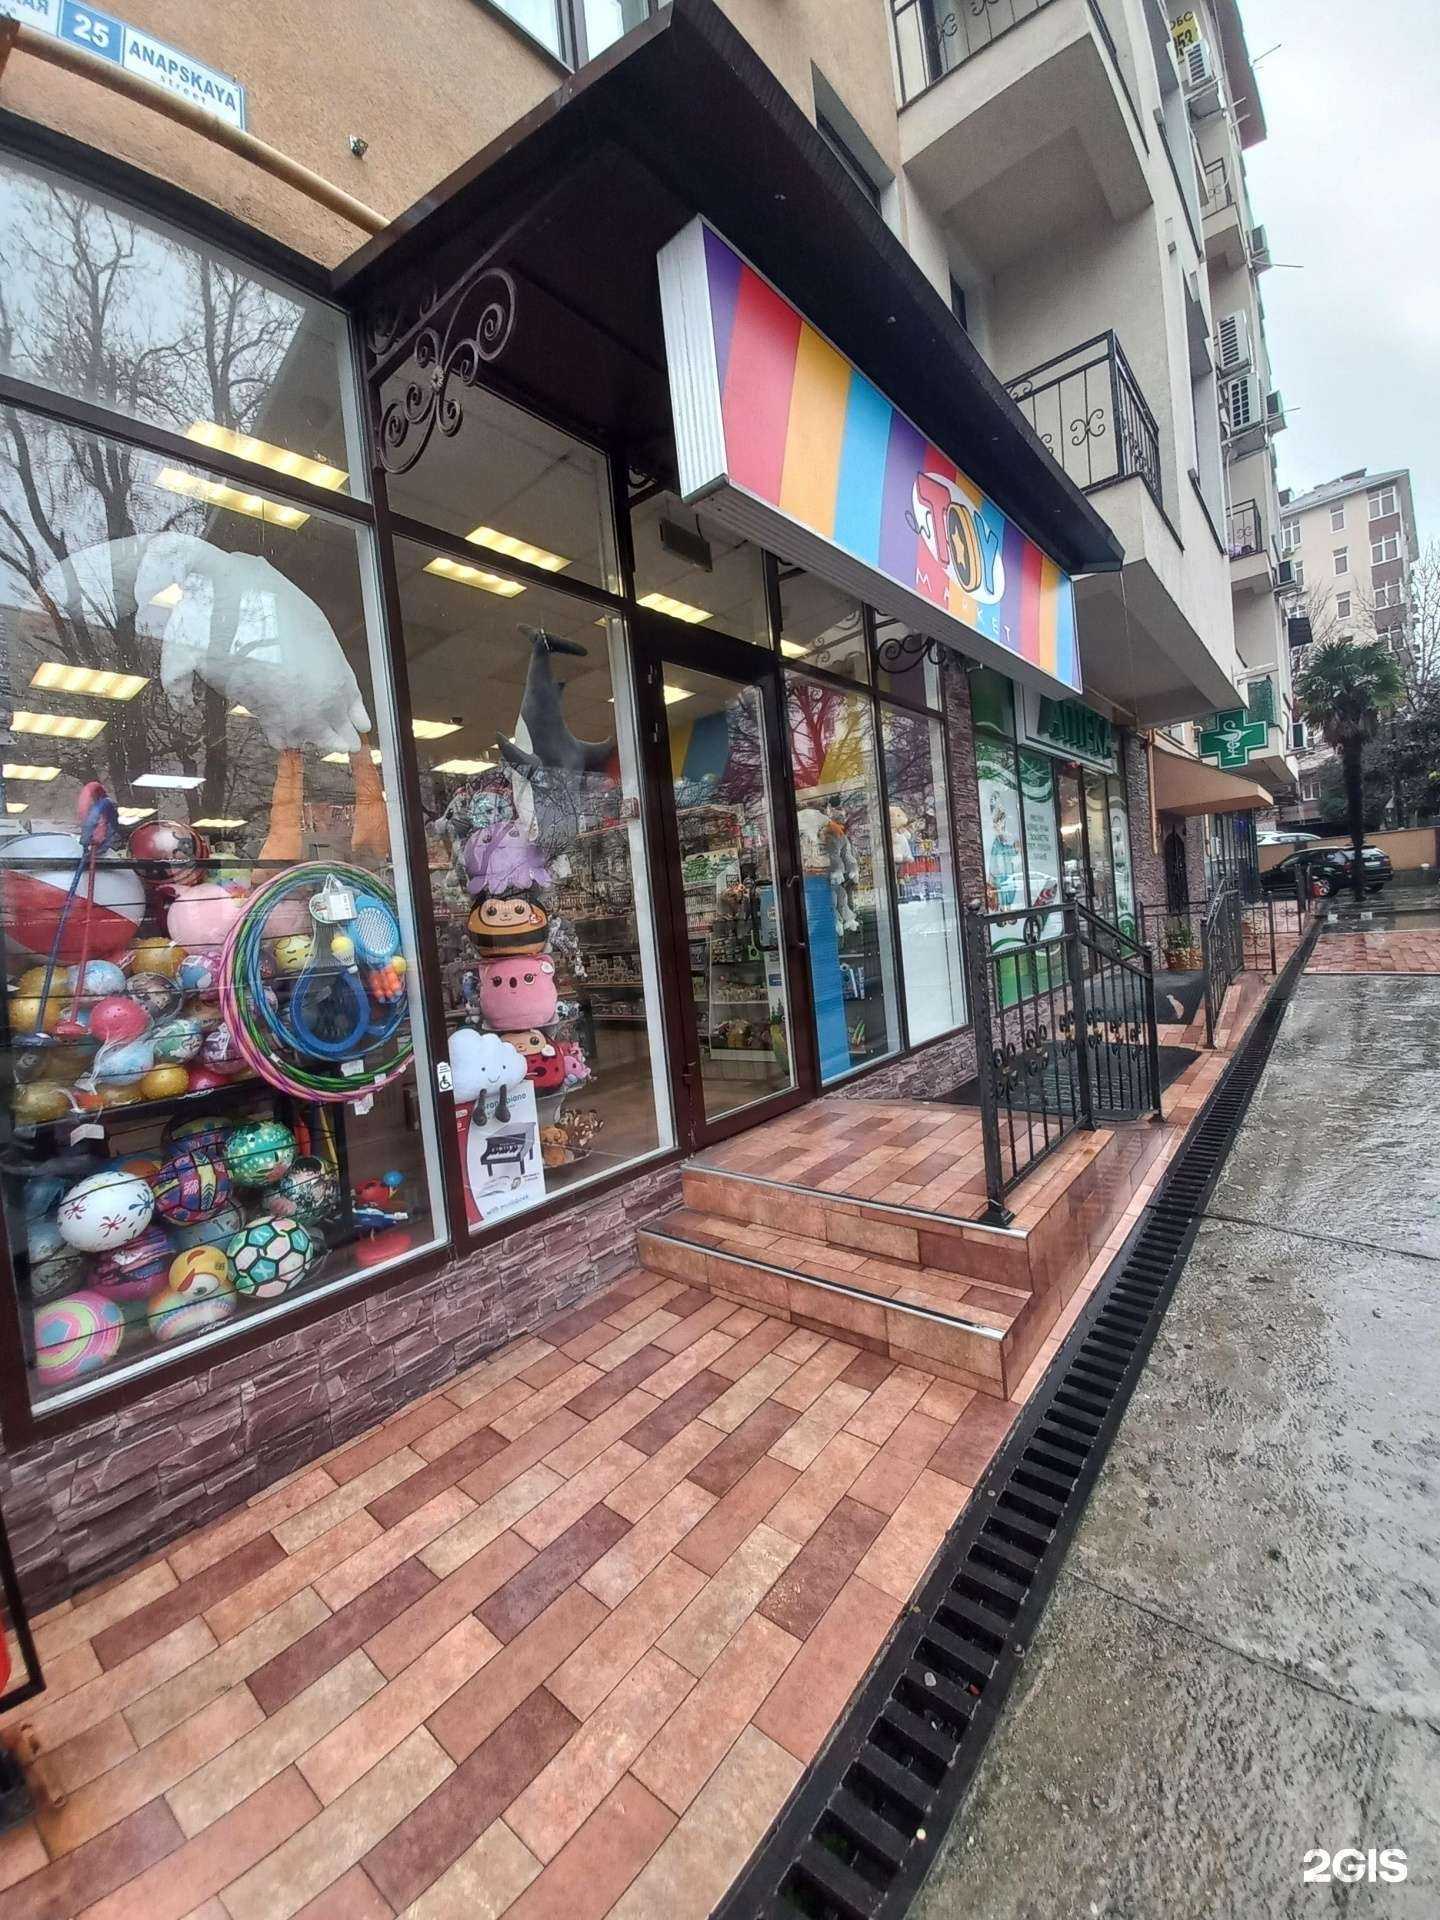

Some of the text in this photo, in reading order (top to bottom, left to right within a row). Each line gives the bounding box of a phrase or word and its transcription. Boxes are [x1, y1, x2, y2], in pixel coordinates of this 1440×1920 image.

[72, 12, 110, 48] 25
[129, 40, 237, 111] ANAPSKAYA
[916, 470, 999, 595] TOY
[915, 567, 1011, 642] MARKET
